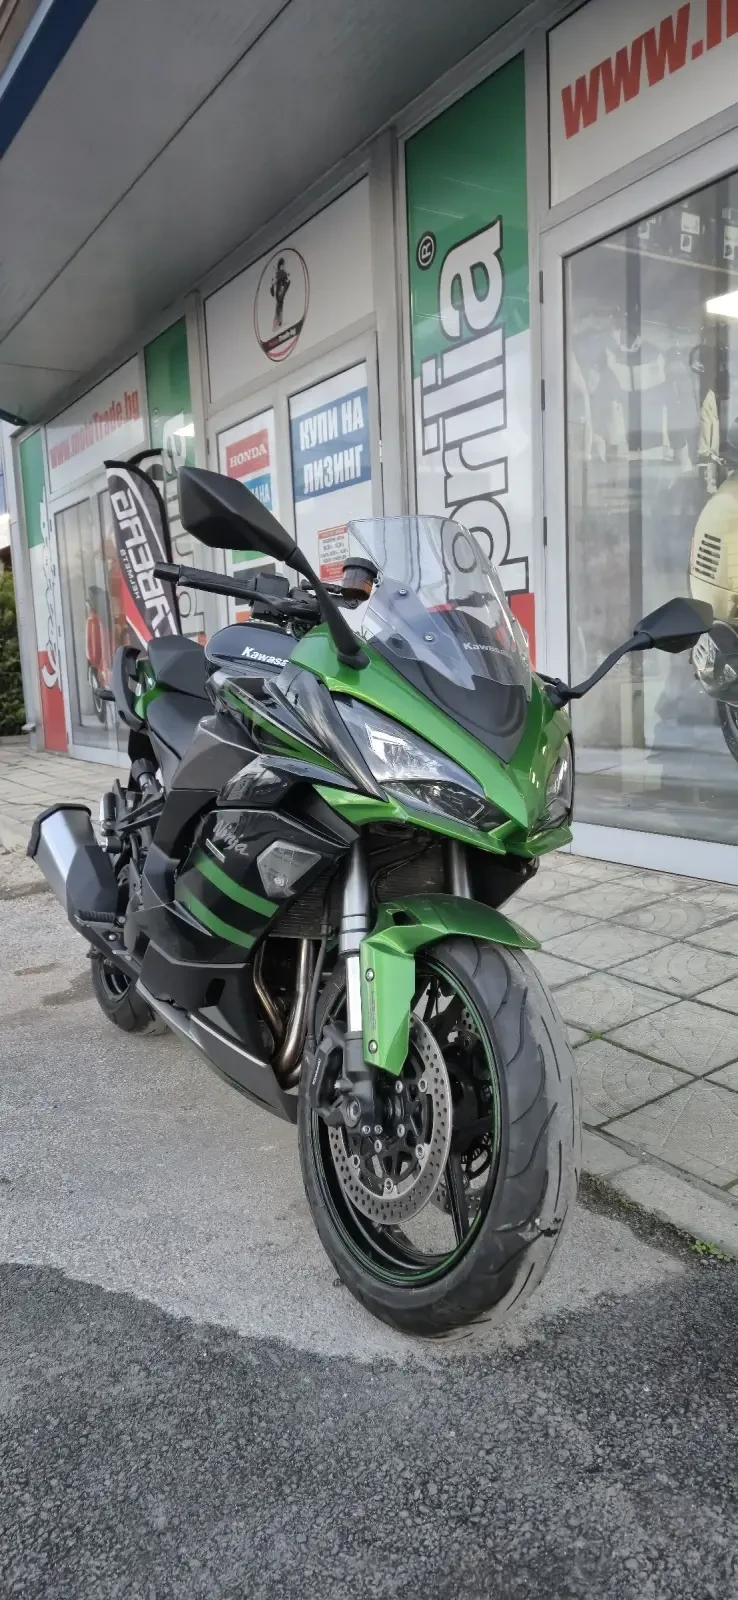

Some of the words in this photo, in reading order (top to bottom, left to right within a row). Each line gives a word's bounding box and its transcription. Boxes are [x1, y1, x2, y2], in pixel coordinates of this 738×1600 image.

[299, 407, 338, 452] КУПИ
[341, 396, 364, 435] НА
[421, 214, 530, 606] prilia
[229, 444, 268, 468] HONDA
[303, 444, 363, 495] ЛИЗИНГ
[241, 646, 290, 667] Kawasa
[212, 819, 249, 857] Ninja
